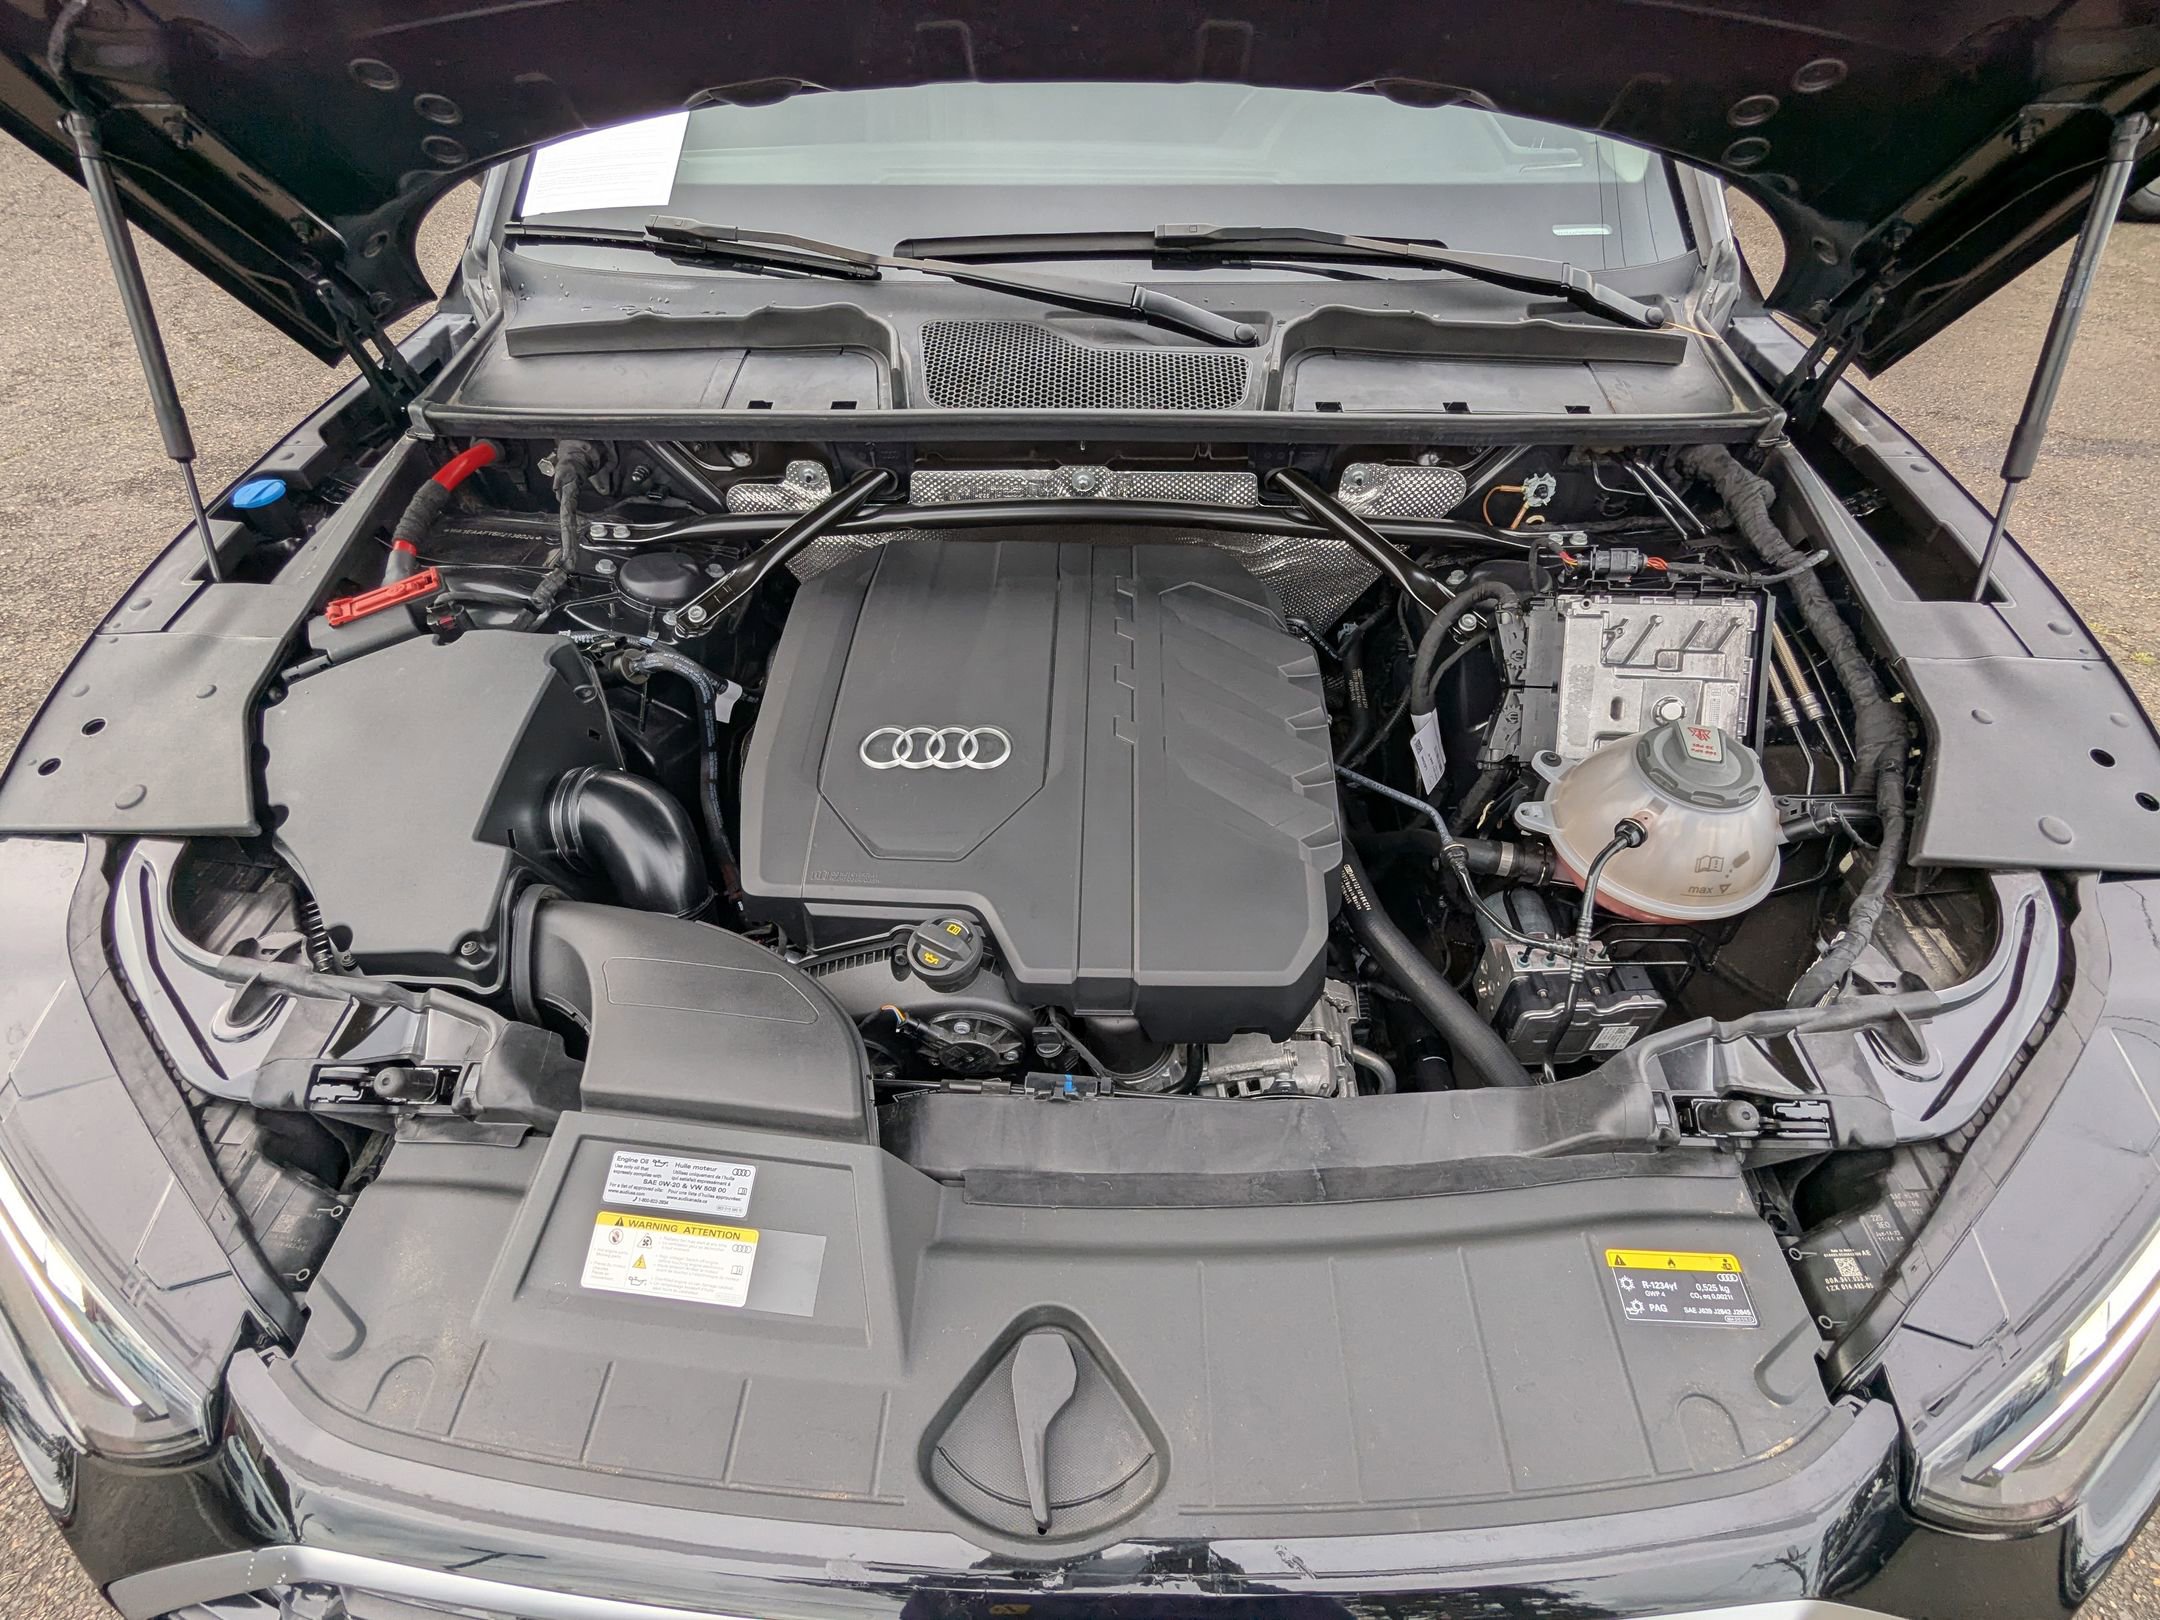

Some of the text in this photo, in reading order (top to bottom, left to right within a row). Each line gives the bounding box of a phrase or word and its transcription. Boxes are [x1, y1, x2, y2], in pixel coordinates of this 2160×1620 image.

[1688, 884, 1713, 895] max
[617, 1155, 638, 1164] Engine
[675, 1162, 718, 1172] Huile moteur
[643, 1178, 658, 1186] SAE
[658, 1180, 681, 1189] 0W-20
[628, 1219, 741, 1240] WARNING ATTENTION
[1641, 1280, 1731, 1294] R-1234yf 0,525 kg
[1648, 1303, 1668, 1313] PAG
[1683, 1306, 1698, 1314] SAE
